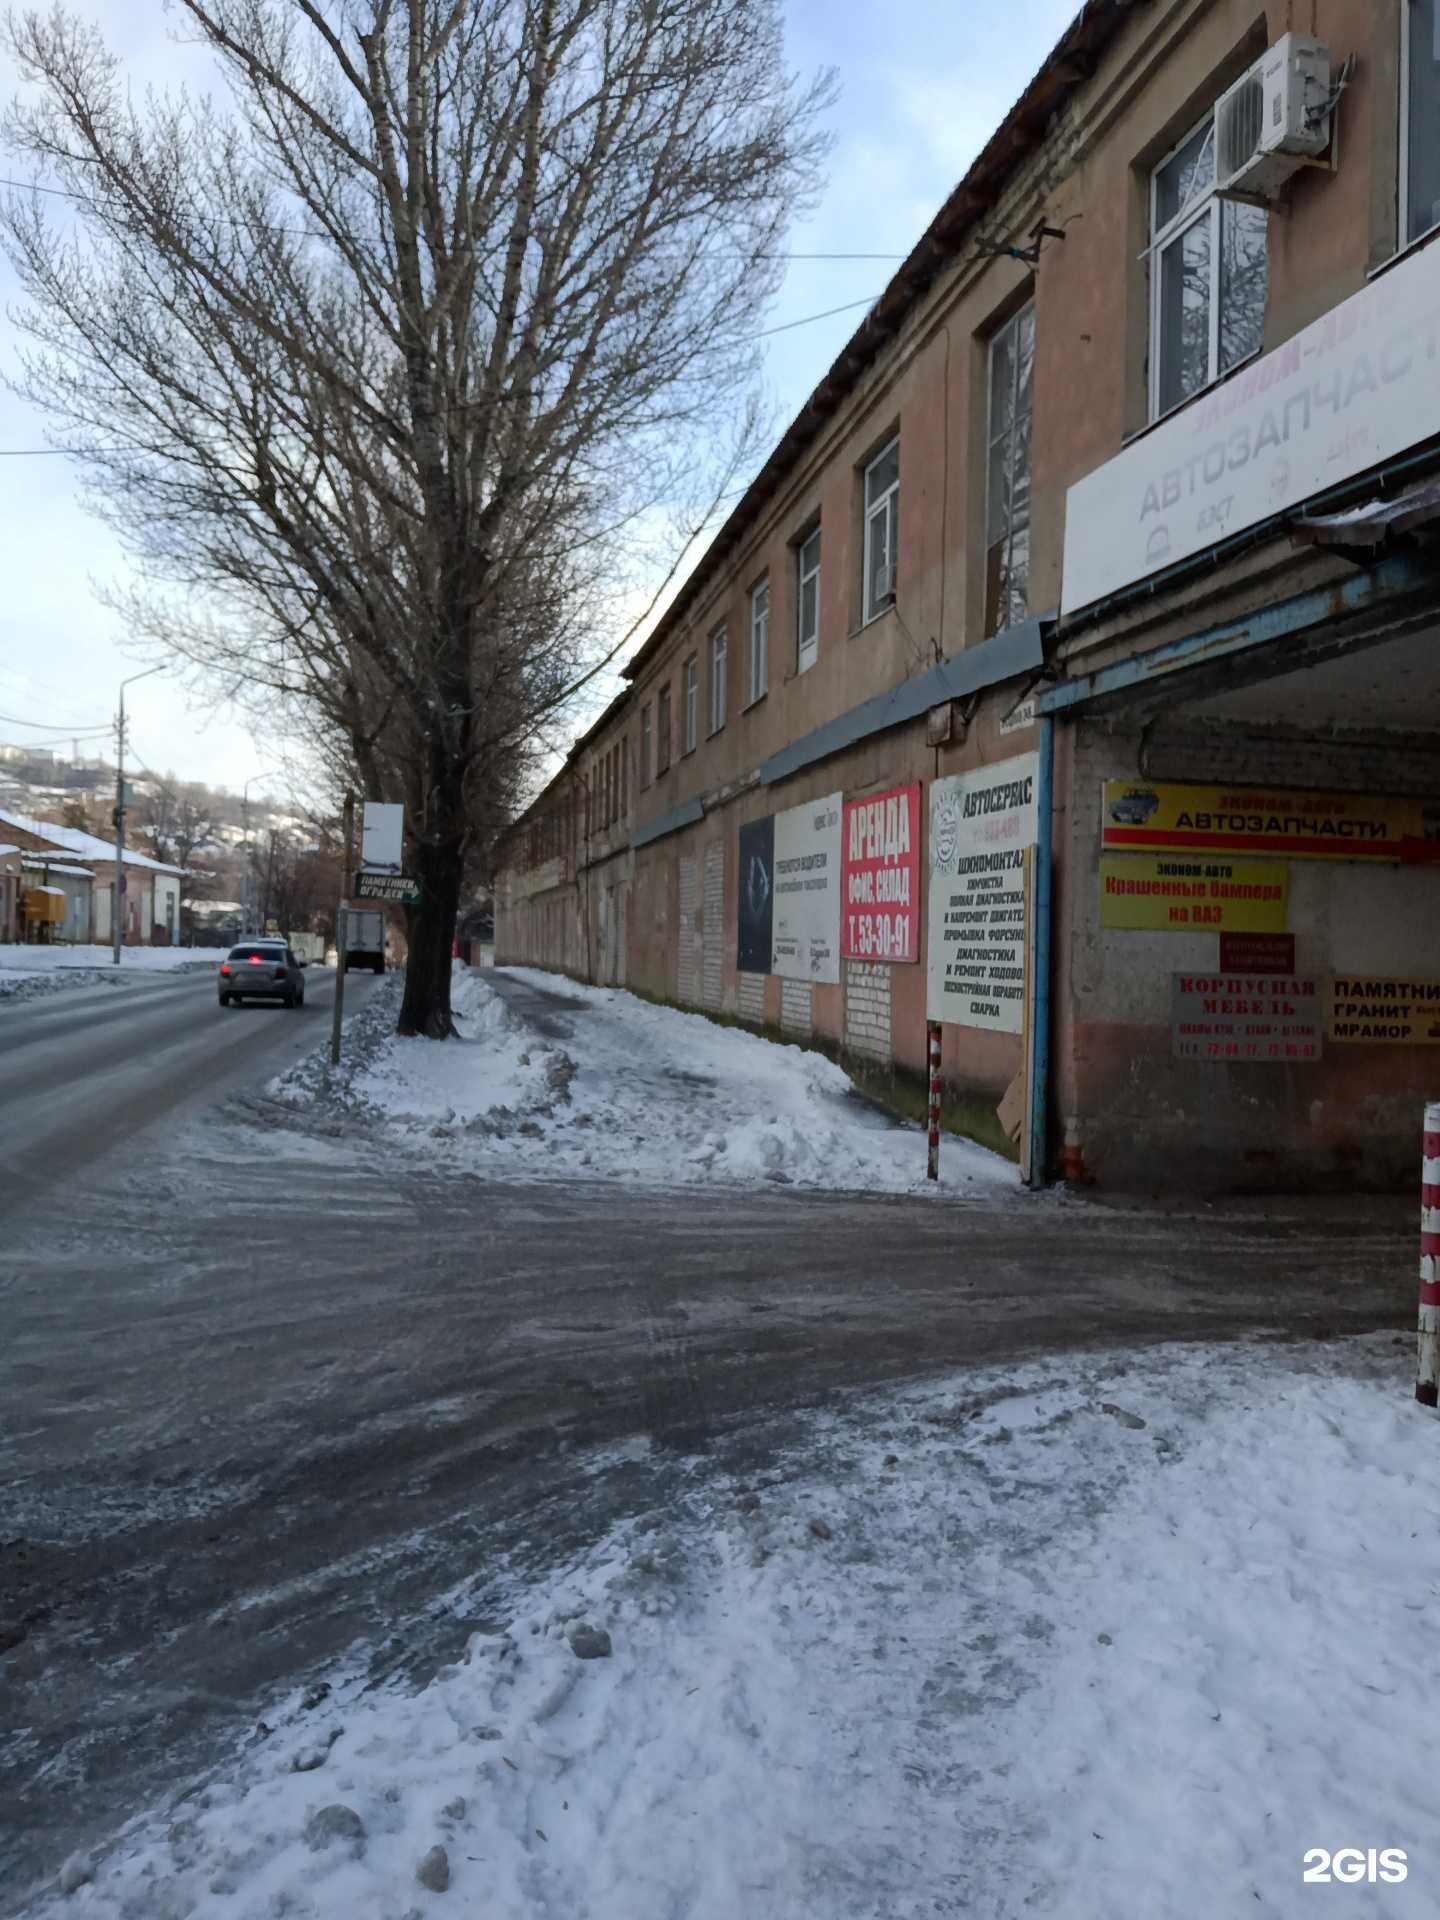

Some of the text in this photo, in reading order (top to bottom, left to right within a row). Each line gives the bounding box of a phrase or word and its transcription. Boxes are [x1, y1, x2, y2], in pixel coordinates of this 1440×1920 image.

[963, 775, 1033, 819] АВТОСЕРВИС
[849, 794, 911, 865] АРЕНДА
[1175, 811, 1389, 839] АВТОЗАПЧАСТИ
[1157, 863, 1234, 878] ЭКОНОМ-АВТО
[848, 869, 876, 904] ОФИС,
[876, 867, 911, 907] СКЛАД
[1105, 876, 1282, 902] Крашенные бампера
[944, 912, 949, 923] И
[990, 908, 1025, 923] ДВИГАТЕ
[1168, 905, 1223, 924] на ВАЗ
[956, 948, 1016, 961] ДИАГНОСТИКА
[946, 964, 1025, 980] И РЕМОНТ ХОДОВО
[1180, 976, 1316, 997] КОРПУСНАЯ
[970, 1001, 1000, 1017] СВАРКА
[1203, 998, 1296, 1017] МЕБЕЛЬ
[1334, 1003, 1411, 1019] ГРАНИТ
[1334, 1023, 1412, 1038] МРАМОР
